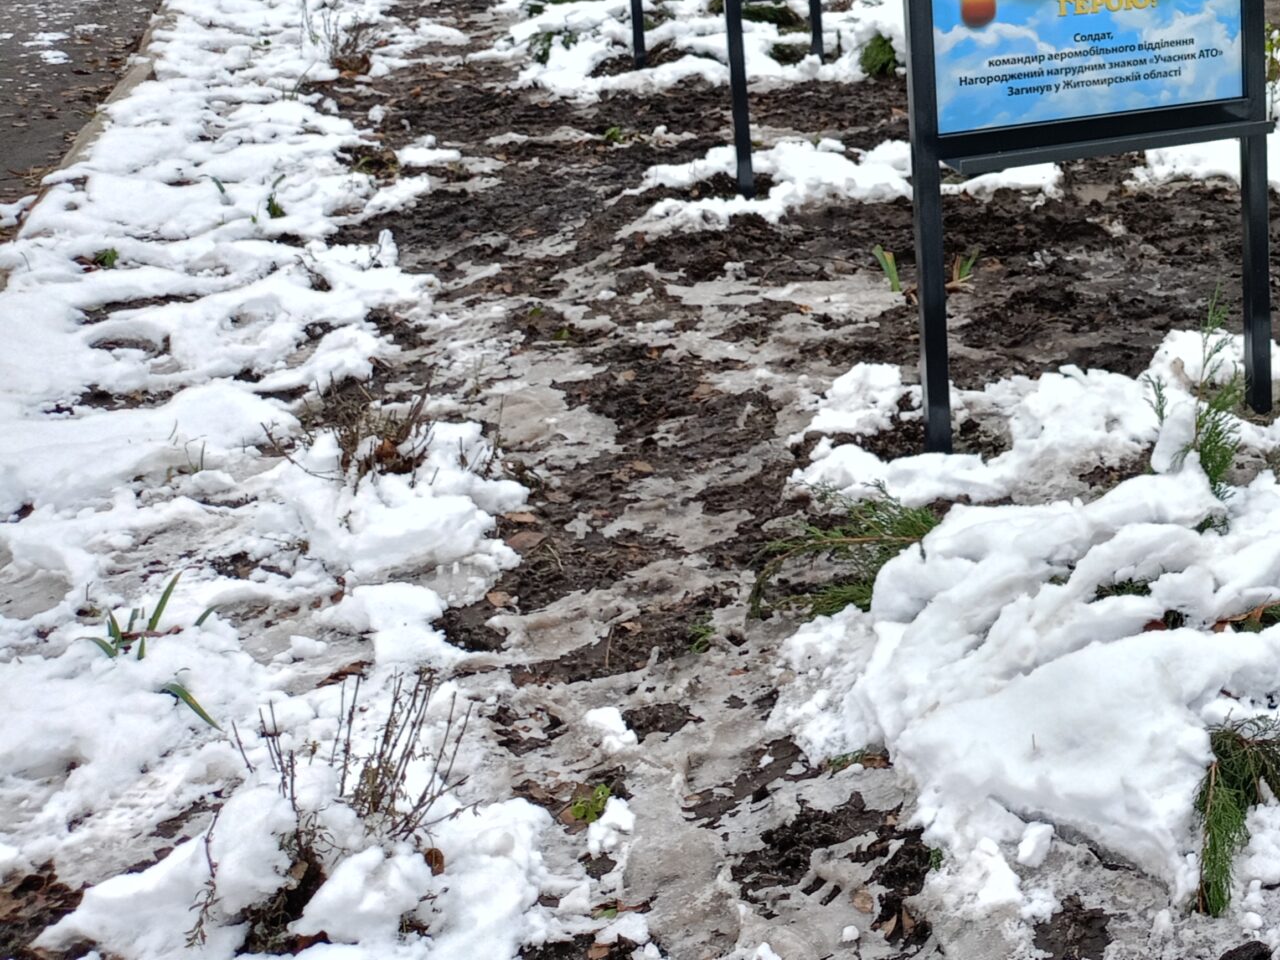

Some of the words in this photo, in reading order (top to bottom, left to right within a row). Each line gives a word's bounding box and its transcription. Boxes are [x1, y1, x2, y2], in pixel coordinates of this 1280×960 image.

[1073, 31, 1114, 43] Солдат,
[959, 67, 1045, 86] Нагороджений
[1046, 62, 1106, 77] нагрудним
[1108, 58, 1148, 70] знаком
[1149, 53, 1197, 64] «Учасник
[1198, 47, 1224, 59] АТО»
[988, 53, 1046, 68] командир
[1047, 43, 1136, 62] аеромобільного
[1137, 38, 1195, 51] відділення
[1007, 83, 1053, 97] Загинув
[1054, 82, 1061, 93] у
[1062, 72, 1141, 90] Житомирській
[1143, 66, 1182, 81] області
